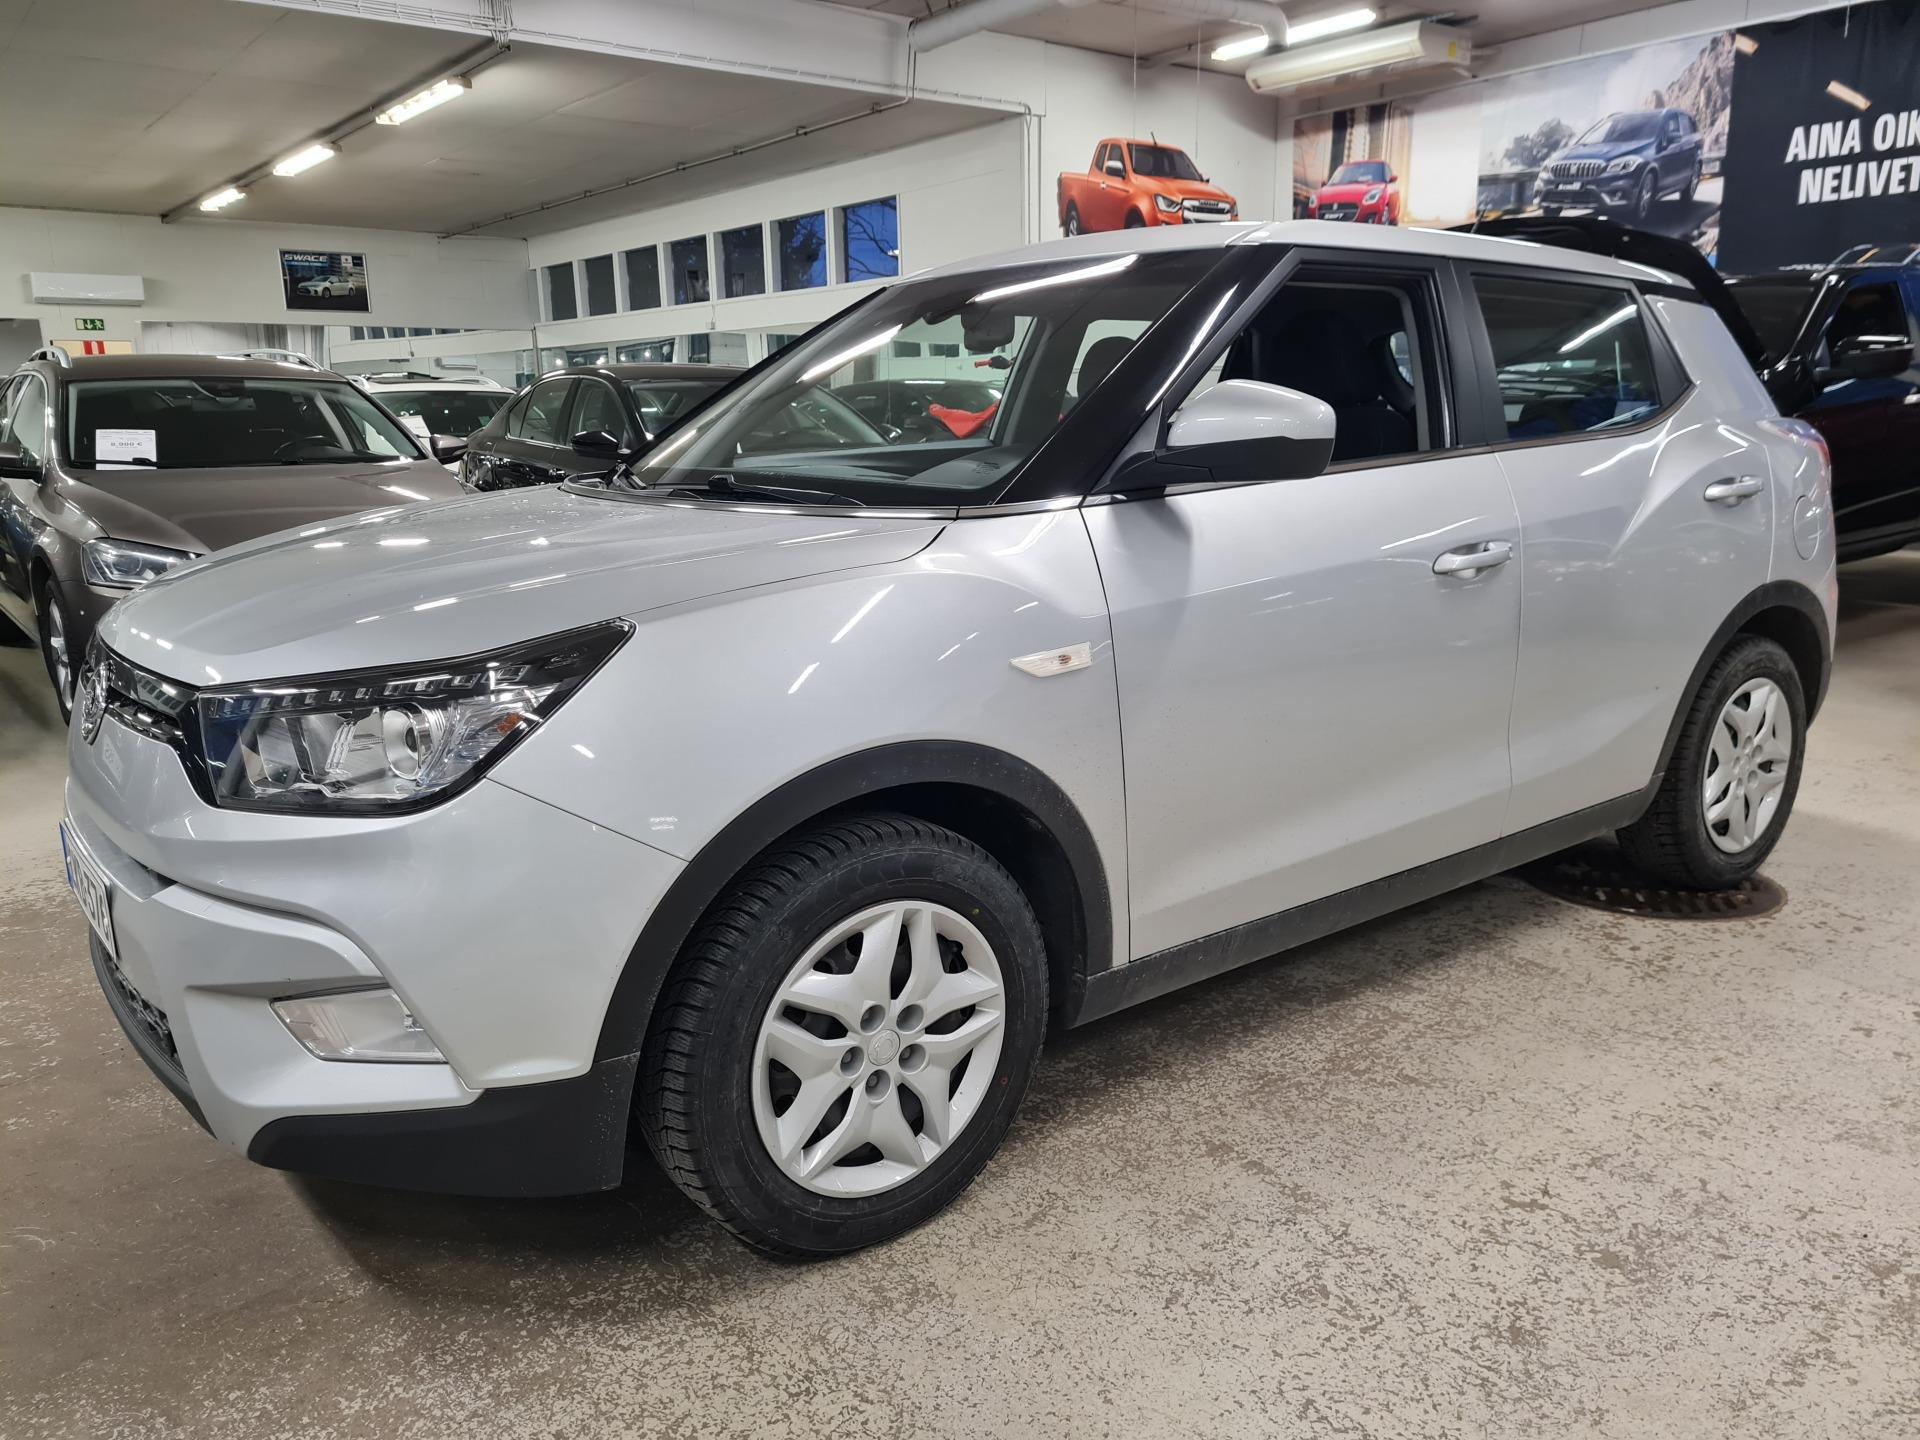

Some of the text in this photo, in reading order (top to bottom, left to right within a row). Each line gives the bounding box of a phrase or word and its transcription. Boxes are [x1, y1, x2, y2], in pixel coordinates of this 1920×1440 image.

[1784, 118, 1861, 164] AINA
[1797, 155, 1920, 206] NELIVET
[284, 254, 328, 262] SWACE
